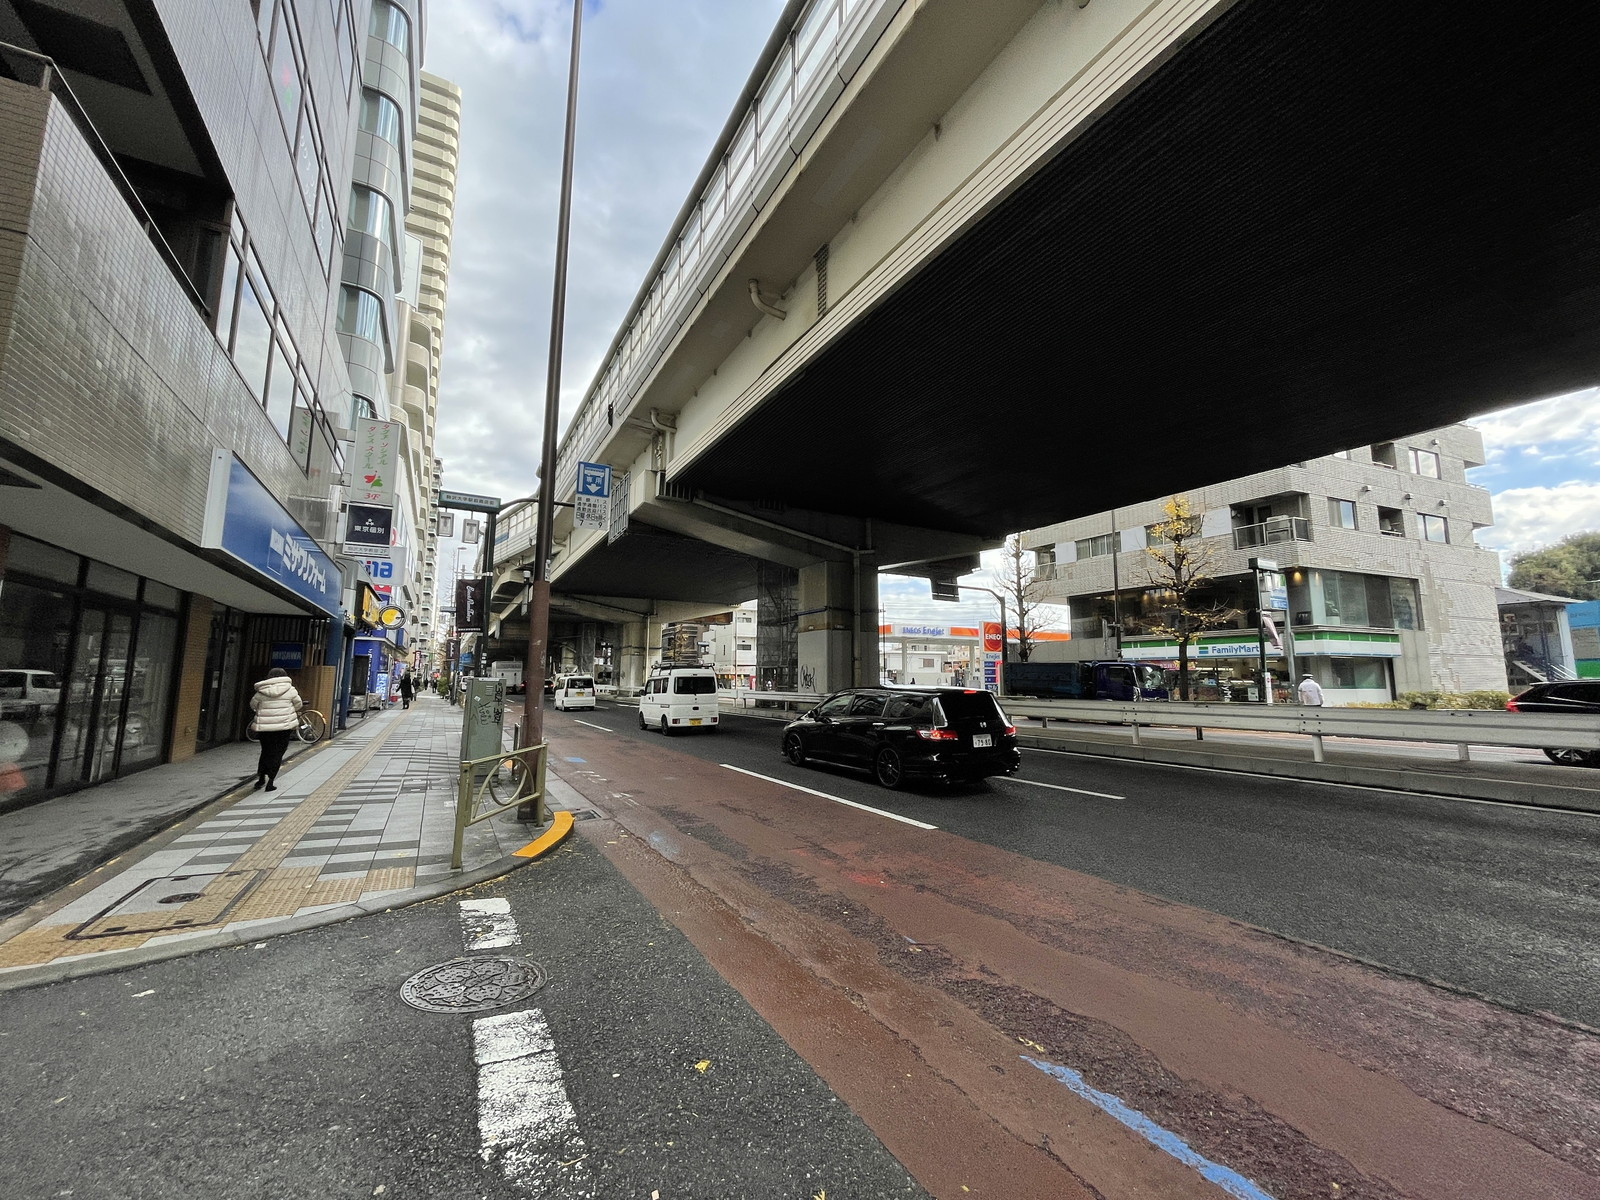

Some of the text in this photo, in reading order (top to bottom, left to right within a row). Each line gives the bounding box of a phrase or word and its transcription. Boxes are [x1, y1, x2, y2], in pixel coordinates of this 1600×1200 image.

[354, 525, 385, 535] 東京個別
[1211, 645, 1260, 655] FamilyMart
